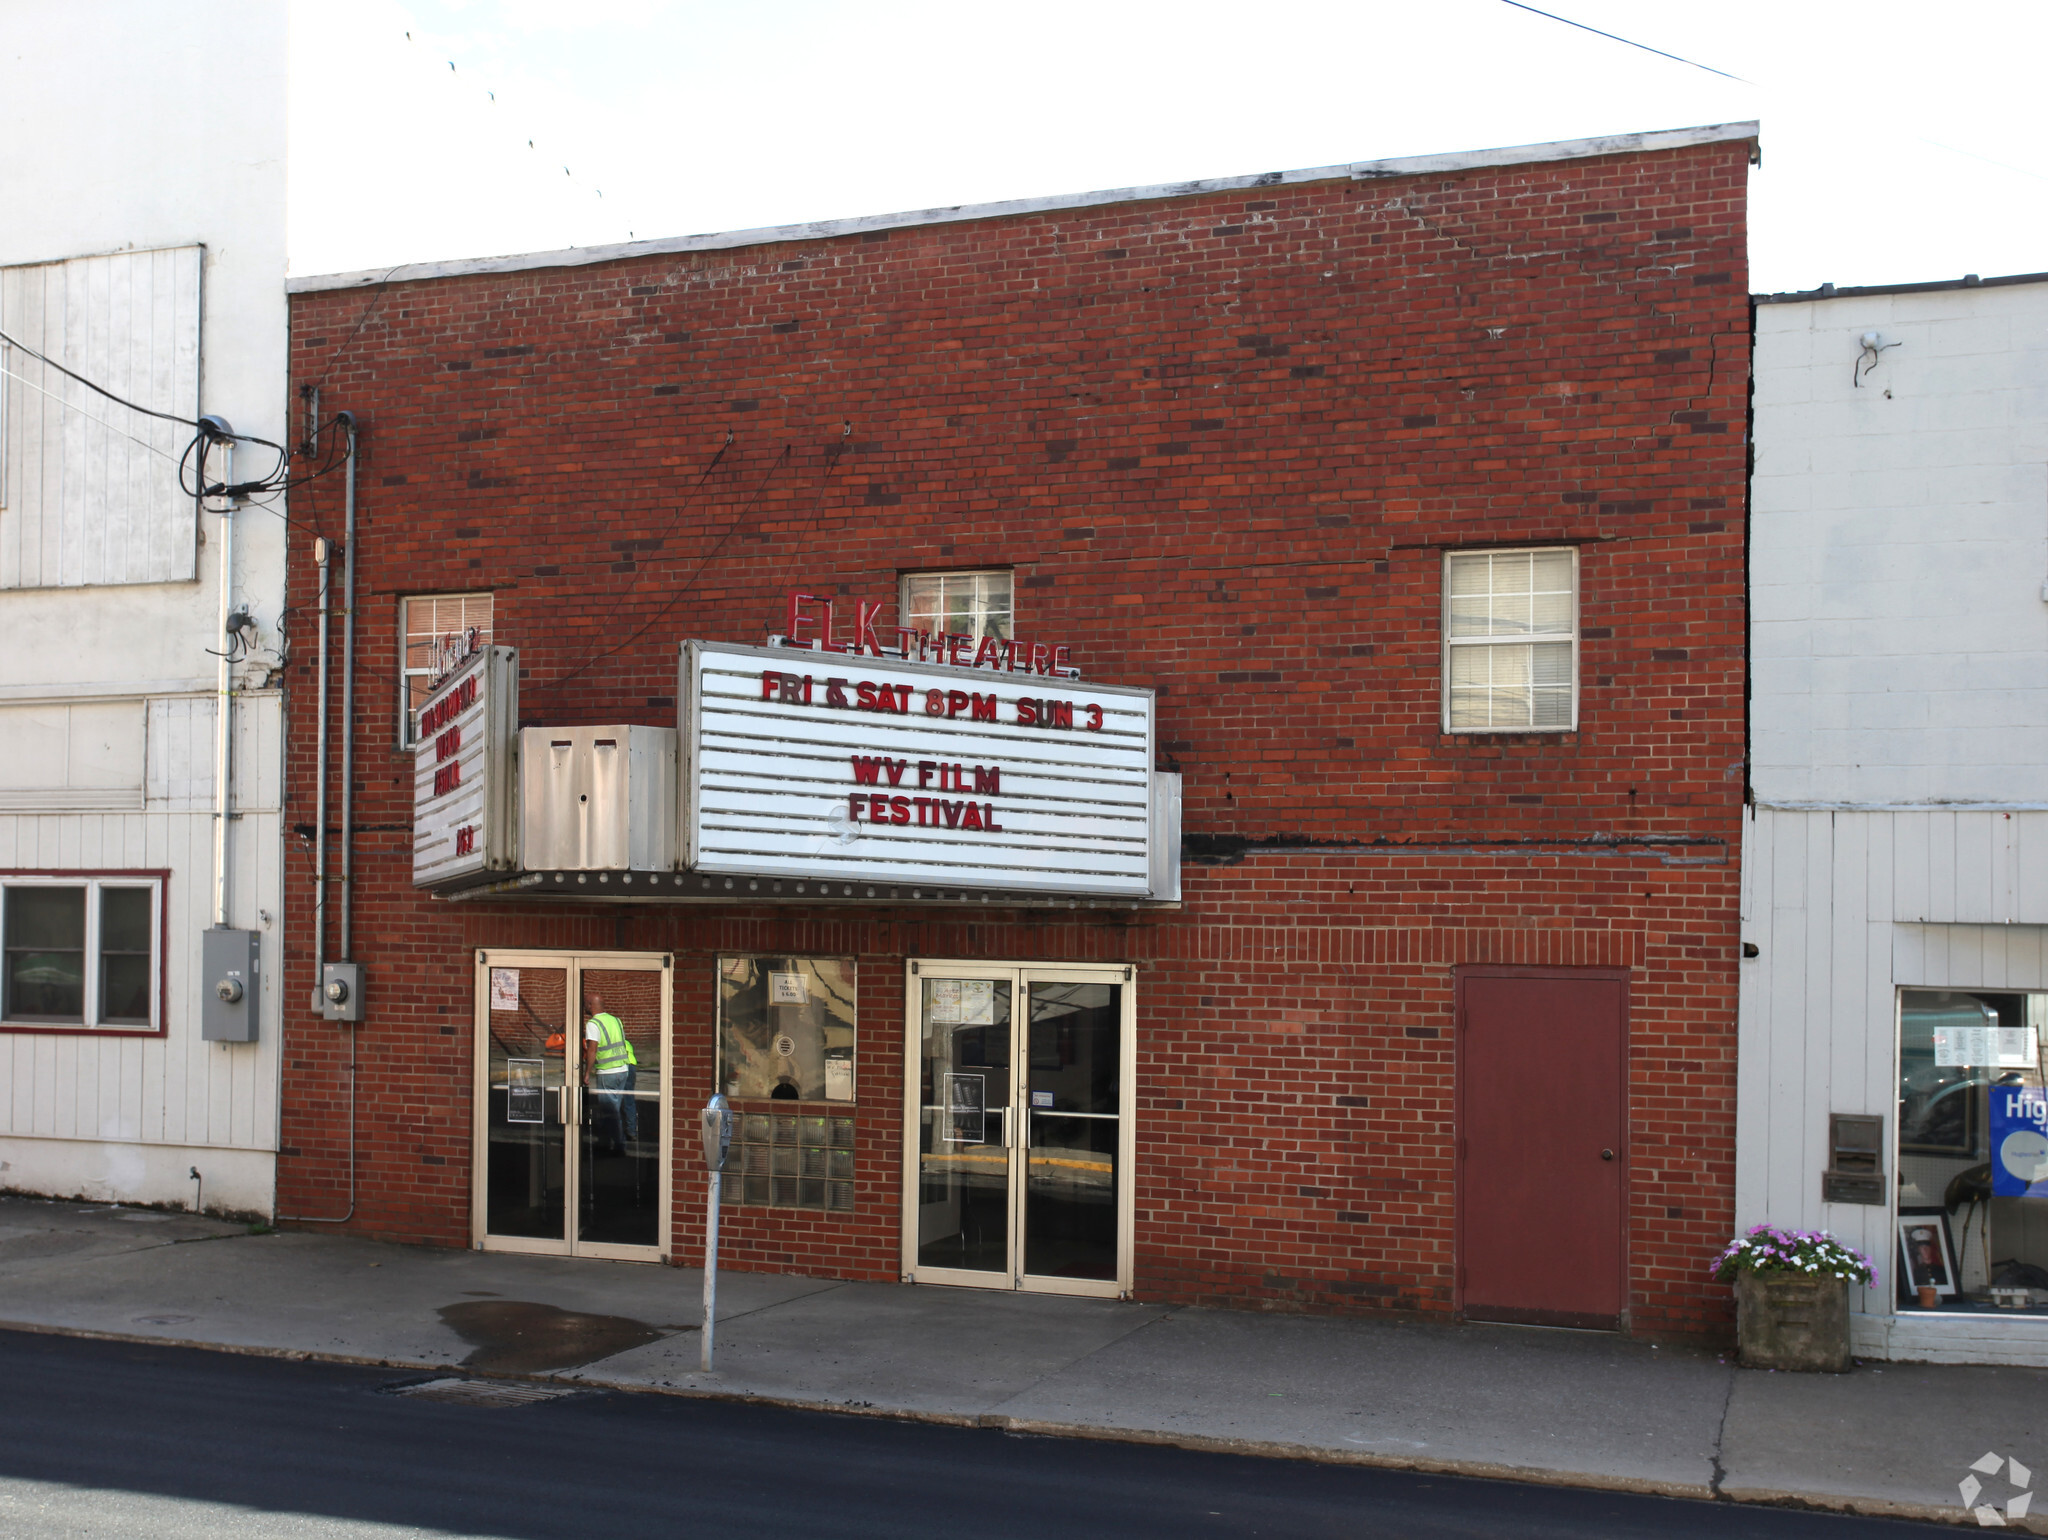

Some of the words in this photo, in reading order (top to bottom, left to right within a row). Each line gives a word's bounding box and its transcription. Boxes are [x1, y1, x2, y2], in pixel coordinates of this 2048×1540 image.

[787, 591, 884, 657] ELK
[894, 626, 1072, 678] THEATRE
[762, 670, 812, 706] FRI
[826, 677, 849, 709] &
[856, 680, 914, 715] SAT
[925, 688, 997, 723] 8PM
[1016, 697, 1074, 730] SUN
[1086, 703, 1104, 731] 3
[851, 755, 907, 787] WV
[919, 760, 1000, 795] FILM
[849, 792, 1003, 832] FESTIVAL
[2006, 1093, 2047, 1125] Hig
